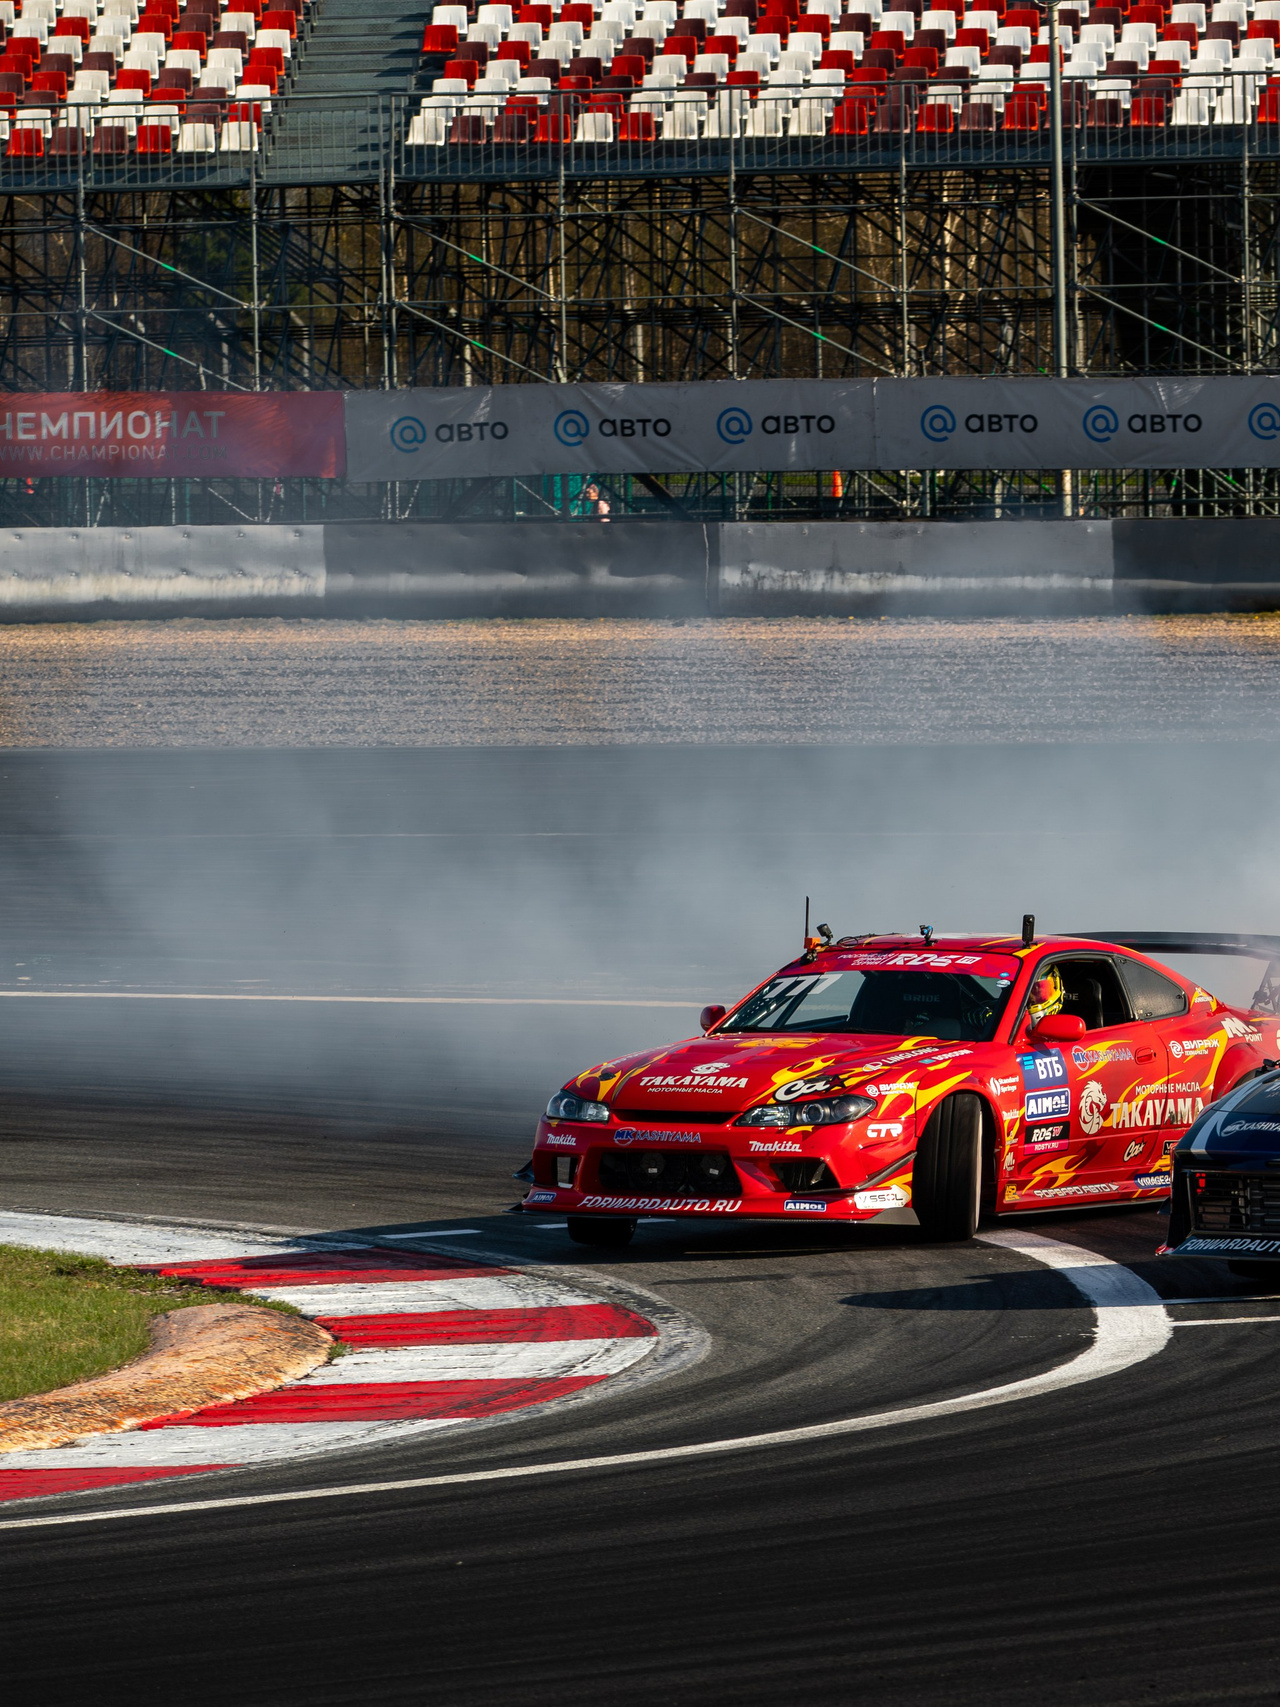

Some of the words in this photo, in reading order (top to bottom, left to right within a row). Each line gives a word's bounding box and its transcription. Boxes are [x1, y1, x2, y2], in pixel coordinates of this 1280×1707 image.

[599, 415, 671, 438] авто
[761, 412, 836, 435] авто
[964, 411, 1038, 434] авто
[1127, 411, 1203, 434] авто
[435, 420, 509, 443] авто
[763, 974, 843, 999] 777
[1182, 1039, 1220, 1050] ВИРАЖ
[1245, 1033, 1262, 1042] POINT
[1088, 1048, 1134, 1063] KASHIYAMA
[1035, 1056, 1063, 1079] ВТБ
[639, 1075, 749, 1088] TAKAYAMA
[879, 1082, 915, 1091] ВИРАЖ
[1135, 1084, 1174, 1095] МОТОРНЫЕ
[1175, 1082, 1200, 1093] МАСЛА
[1027, 1094, 1068, 1116] AIMOL
[1110, 1097, 1206, 1129] TAKAYAMA
[636, 1130, 702, 1143] KASHIYAMA
[867, 1124, 903, 1137] CTR
[1031, 1127, 1053, 1142] RDS
[1034, 1142, 1059, 1151] RDSTV.RU
[1084, 1183, 1109, 1194] АВТО
[577, 1196, 742, 1212] FORWARDAUTO.RU
[786, 1202, 824, 1210] AIMOL
[859, 1194, 903, 1203] VSSOL
